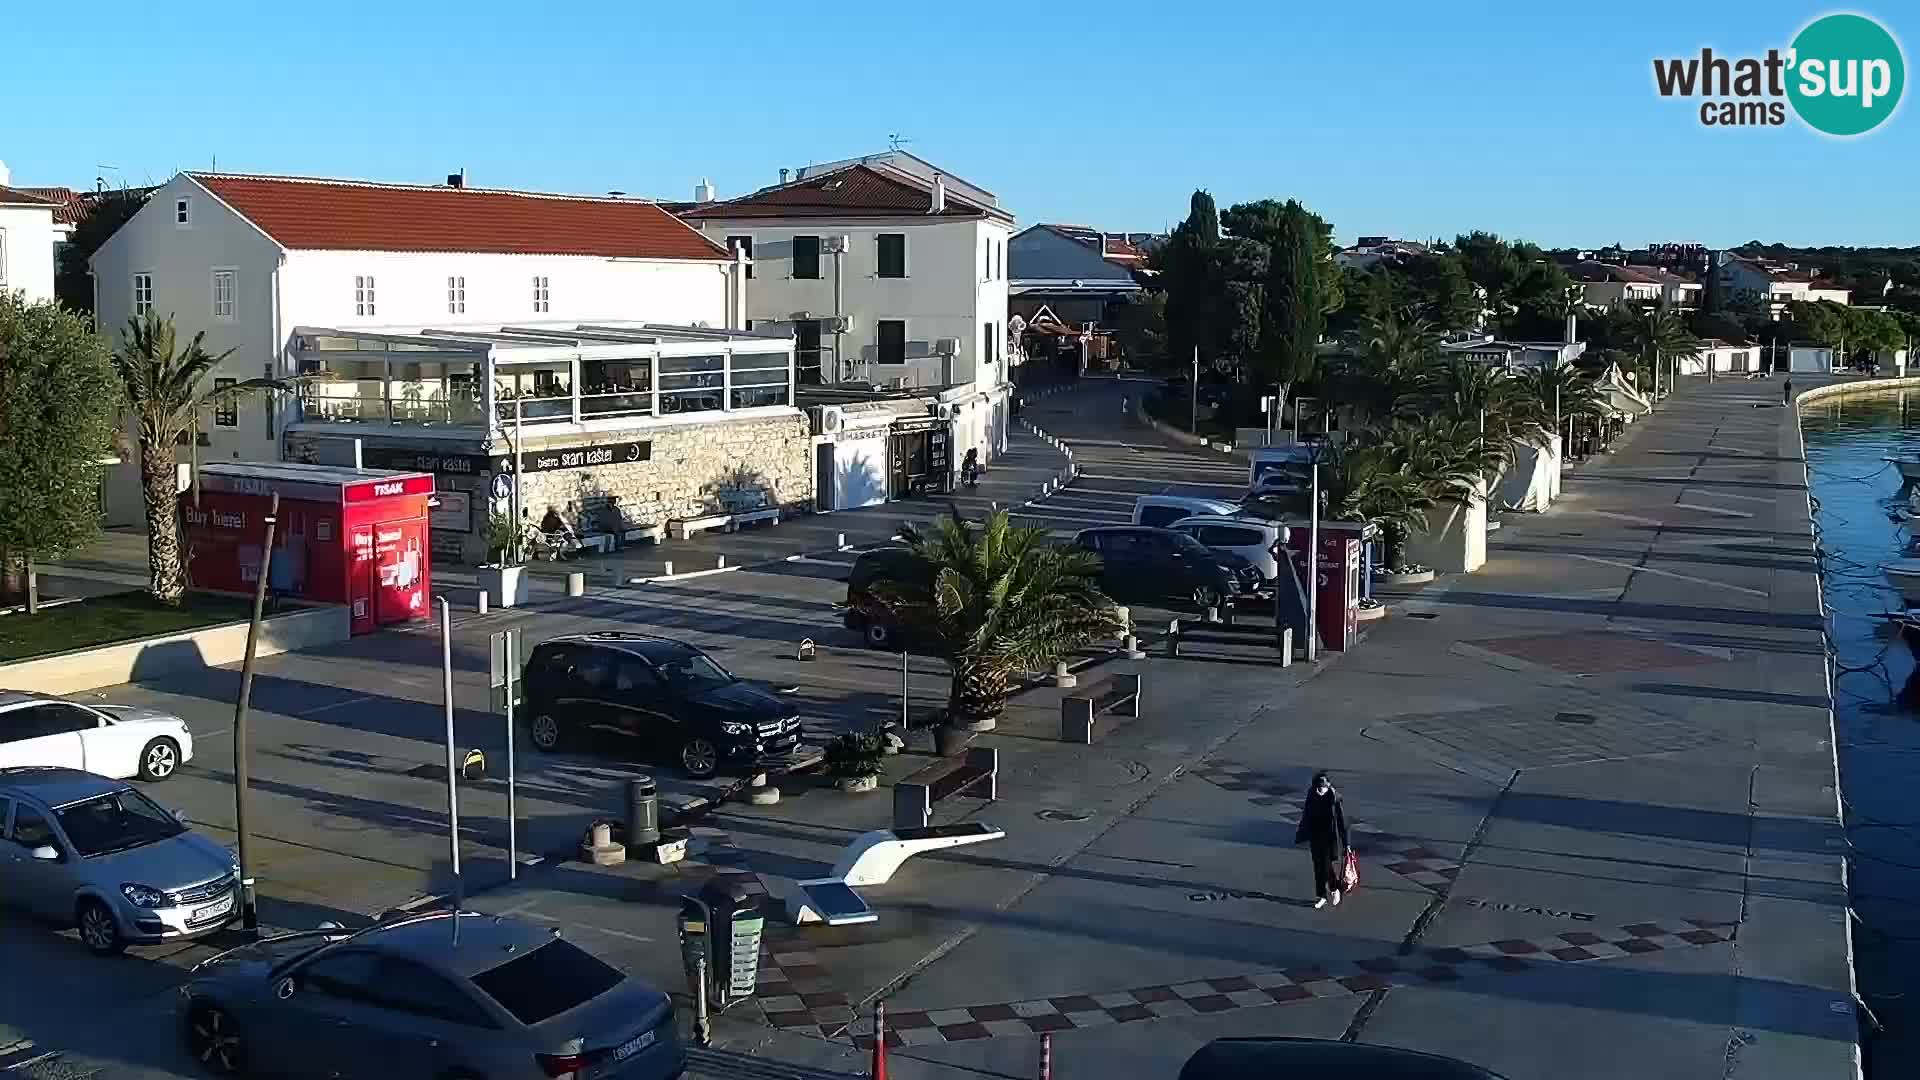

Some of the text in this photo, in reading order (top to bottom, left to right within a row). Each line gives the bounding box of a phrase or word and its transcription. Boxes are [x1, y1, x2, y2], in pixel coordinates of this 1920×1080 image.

[846, 431, 884, 440] MARKET
[537, 457, 559, 468] bistro
[374, 482, 404, 496] TISAK
[185, 505, 208, 527] Buy
